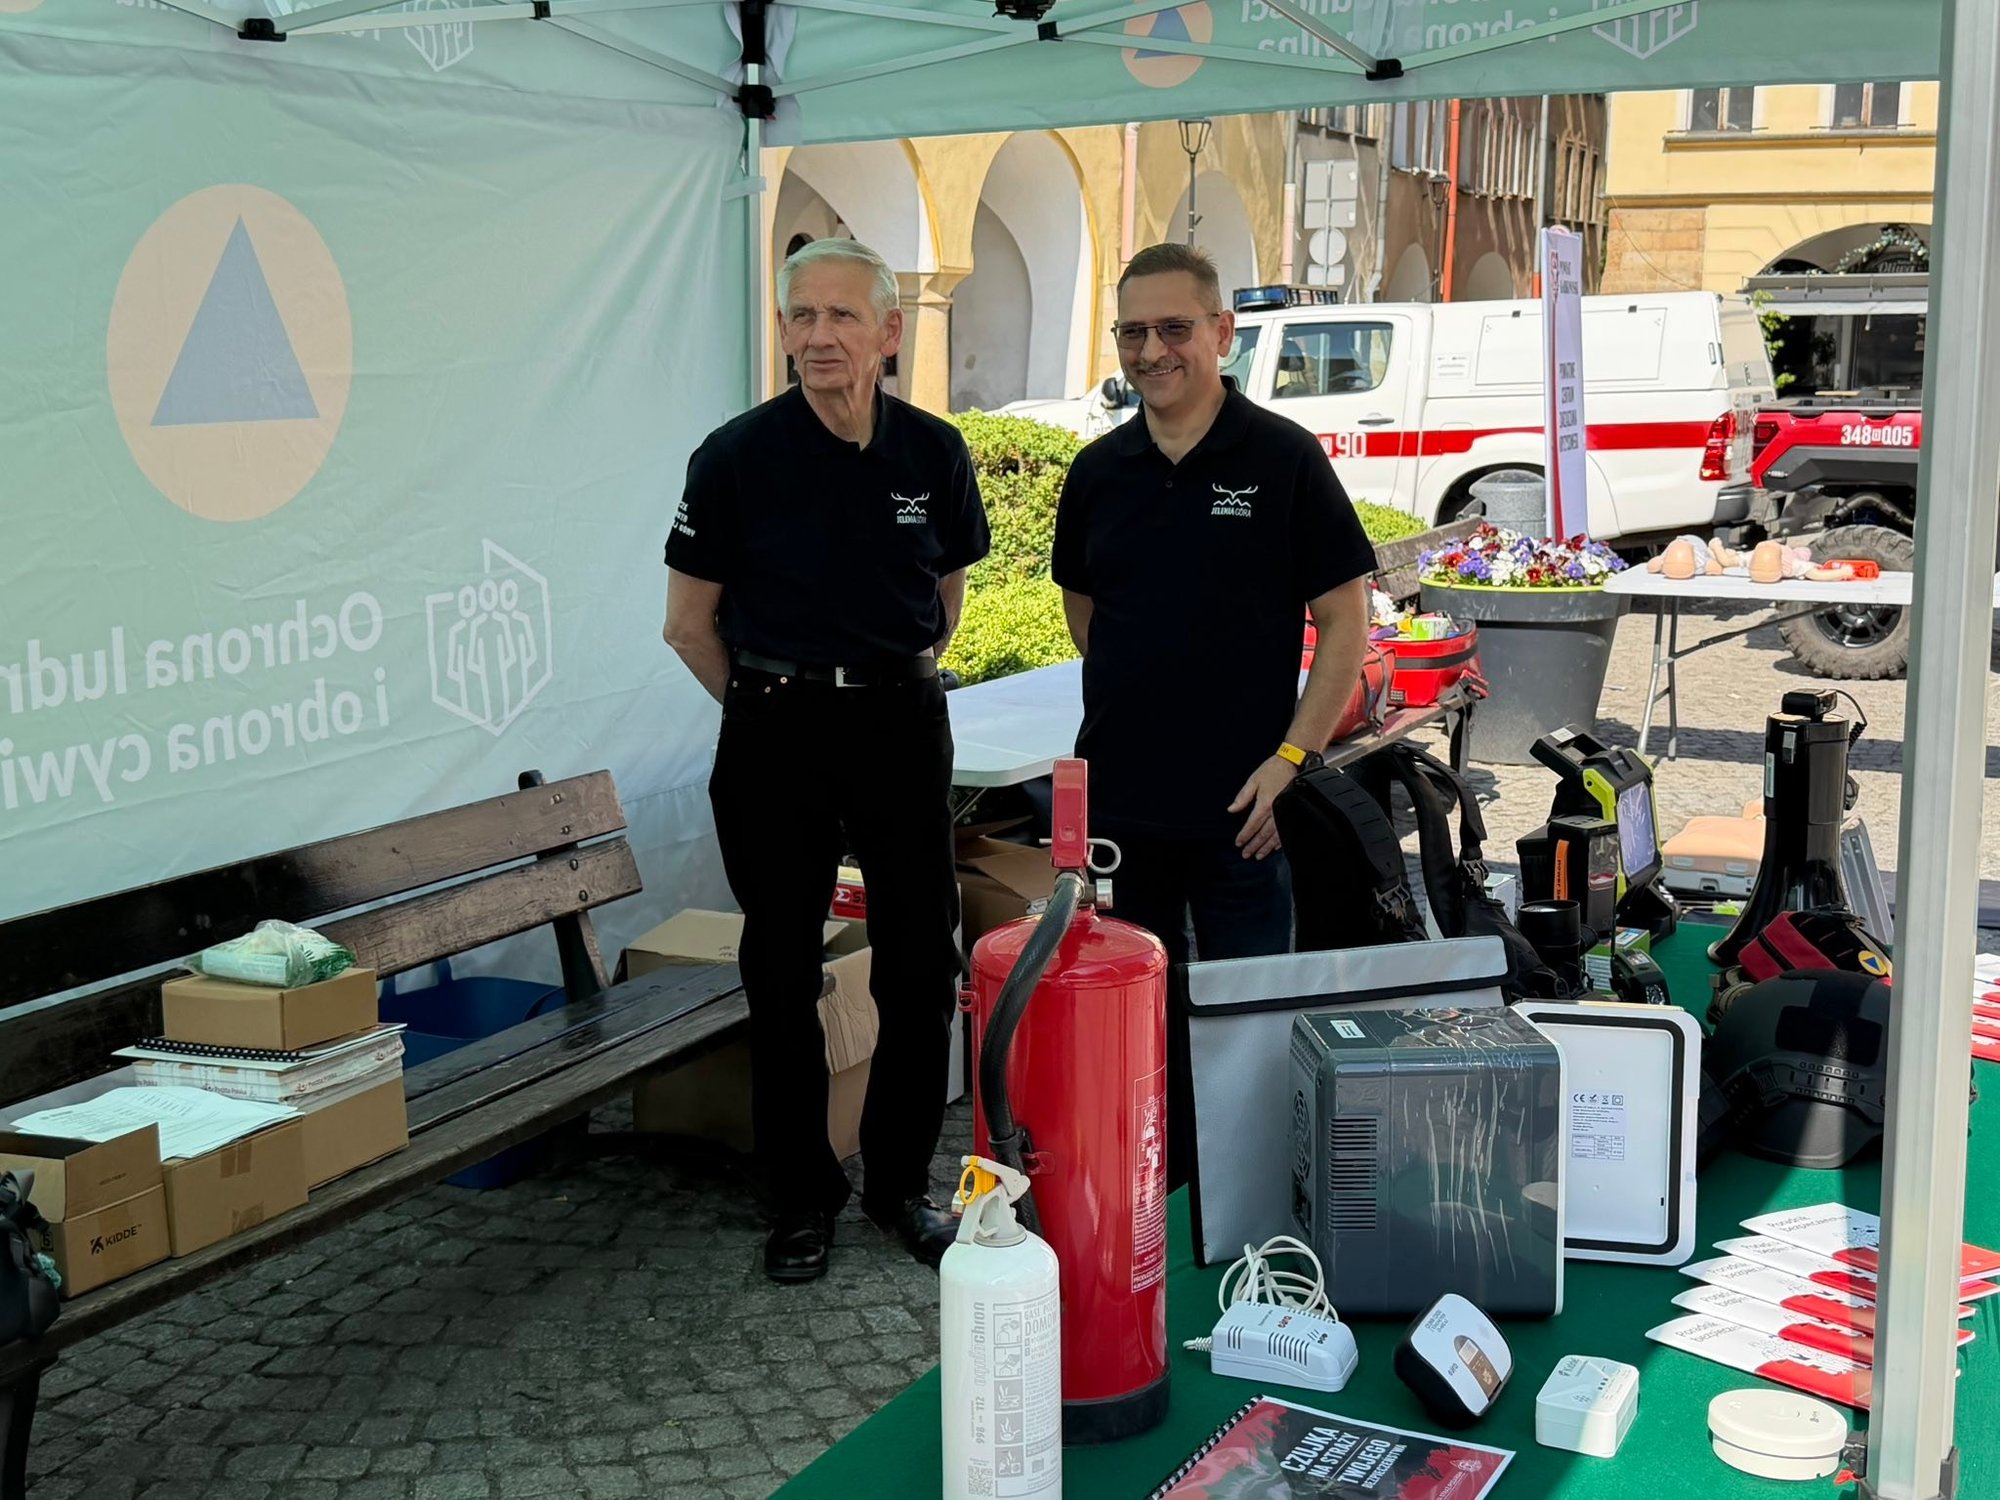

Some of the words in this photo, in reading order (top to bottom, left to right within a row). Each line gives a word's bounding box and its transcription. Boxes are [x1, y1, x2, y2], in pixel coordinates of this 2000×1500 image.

[105, 1226, 138, 1246] KIDDE
[975, 1396, 985, 1411] 112
[975, 1426, 985, 1444] 998
[1279, 1426, 1340, 1472] CZUJKA
[1308, 1464, 1333, 1478] NA
[1337, 1439, 1391, 1485] TWOJEGO
